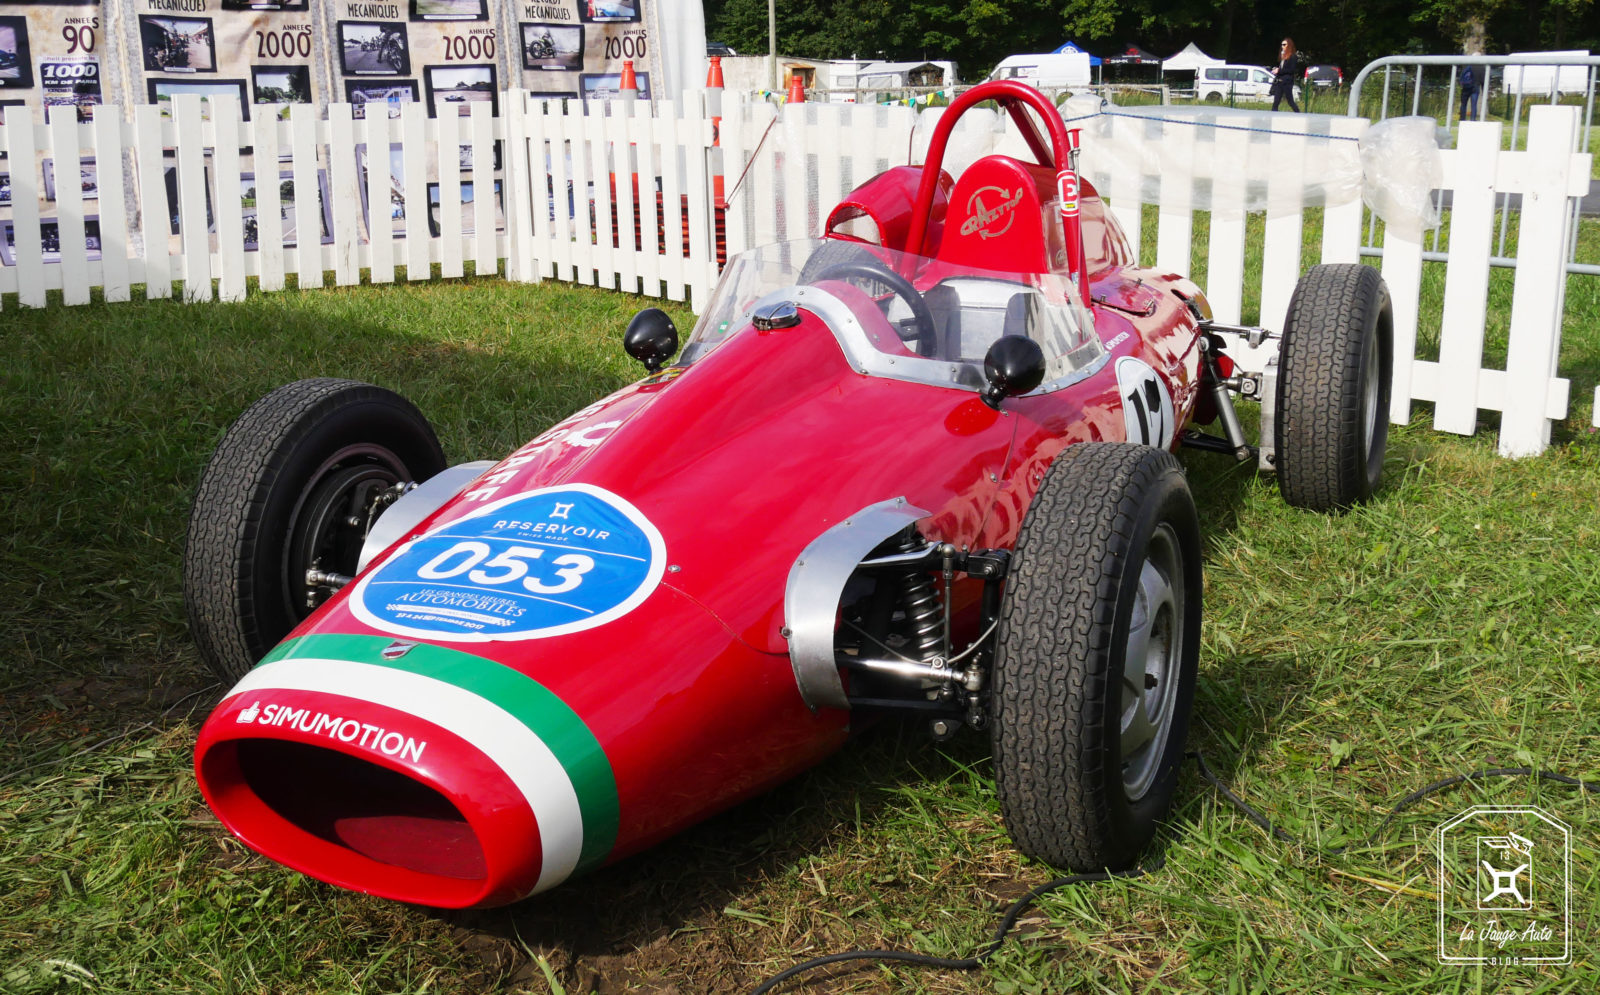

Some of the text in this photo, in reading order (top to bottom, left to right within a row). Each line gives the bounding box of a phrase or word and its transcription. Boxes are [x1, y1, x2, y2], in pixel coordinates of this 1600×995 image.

[62, 25, 95, 54] 90
[256, 30, 311, 58] 2000
[442, 35, 495, 60] 2000
[605, 36, 646, 60] 2000
[43, 64, 97, 78] 1000
[493, 520, 610, 540] RESERVOIR
[417, 541, 595, 594] 053
[395, 592, 527, 617] AUTOMOBILES
[258, 703, 427, 763] SIMUMOTION
